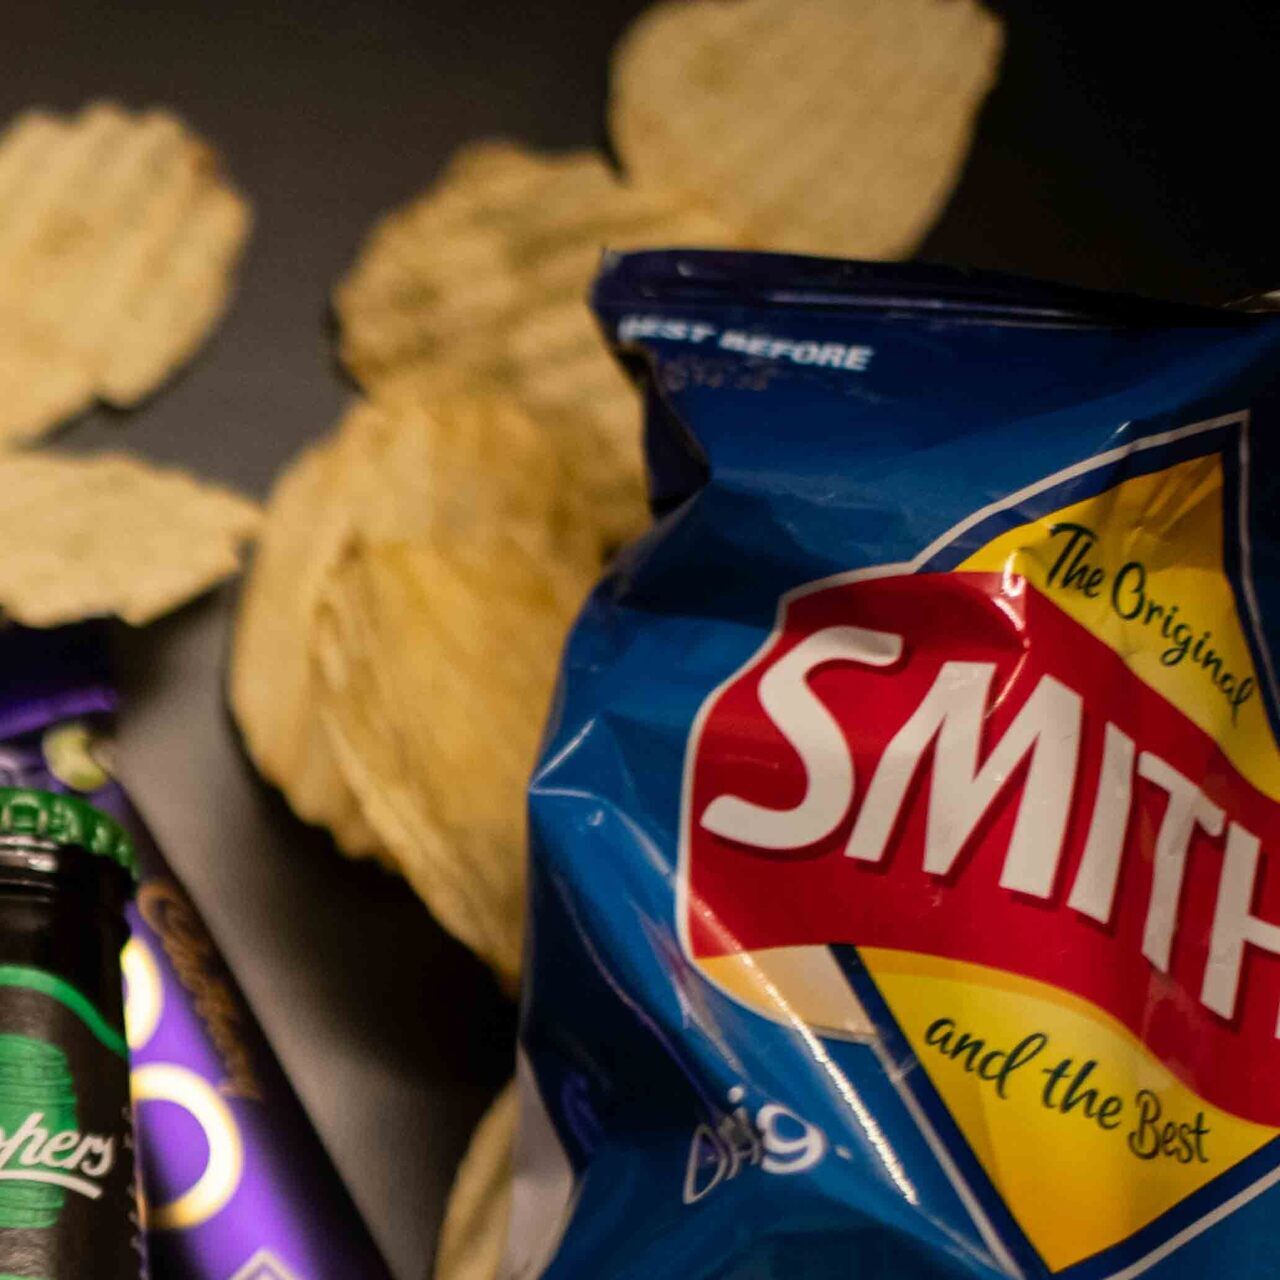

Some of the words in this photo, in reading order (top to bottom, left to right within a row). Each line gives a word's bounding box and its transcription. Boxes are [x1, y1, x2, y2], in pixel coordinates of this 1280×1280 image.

[718, 329, 874, 371] BEFORE
[1048, 521, 1103, 599] The
[1112, 561, 1258, 728] Original
[924, 1017, 1048, 1101] and
[1042, 1059, 1124, 1131] the
[1127, 1088, 1212, 1164] Best
